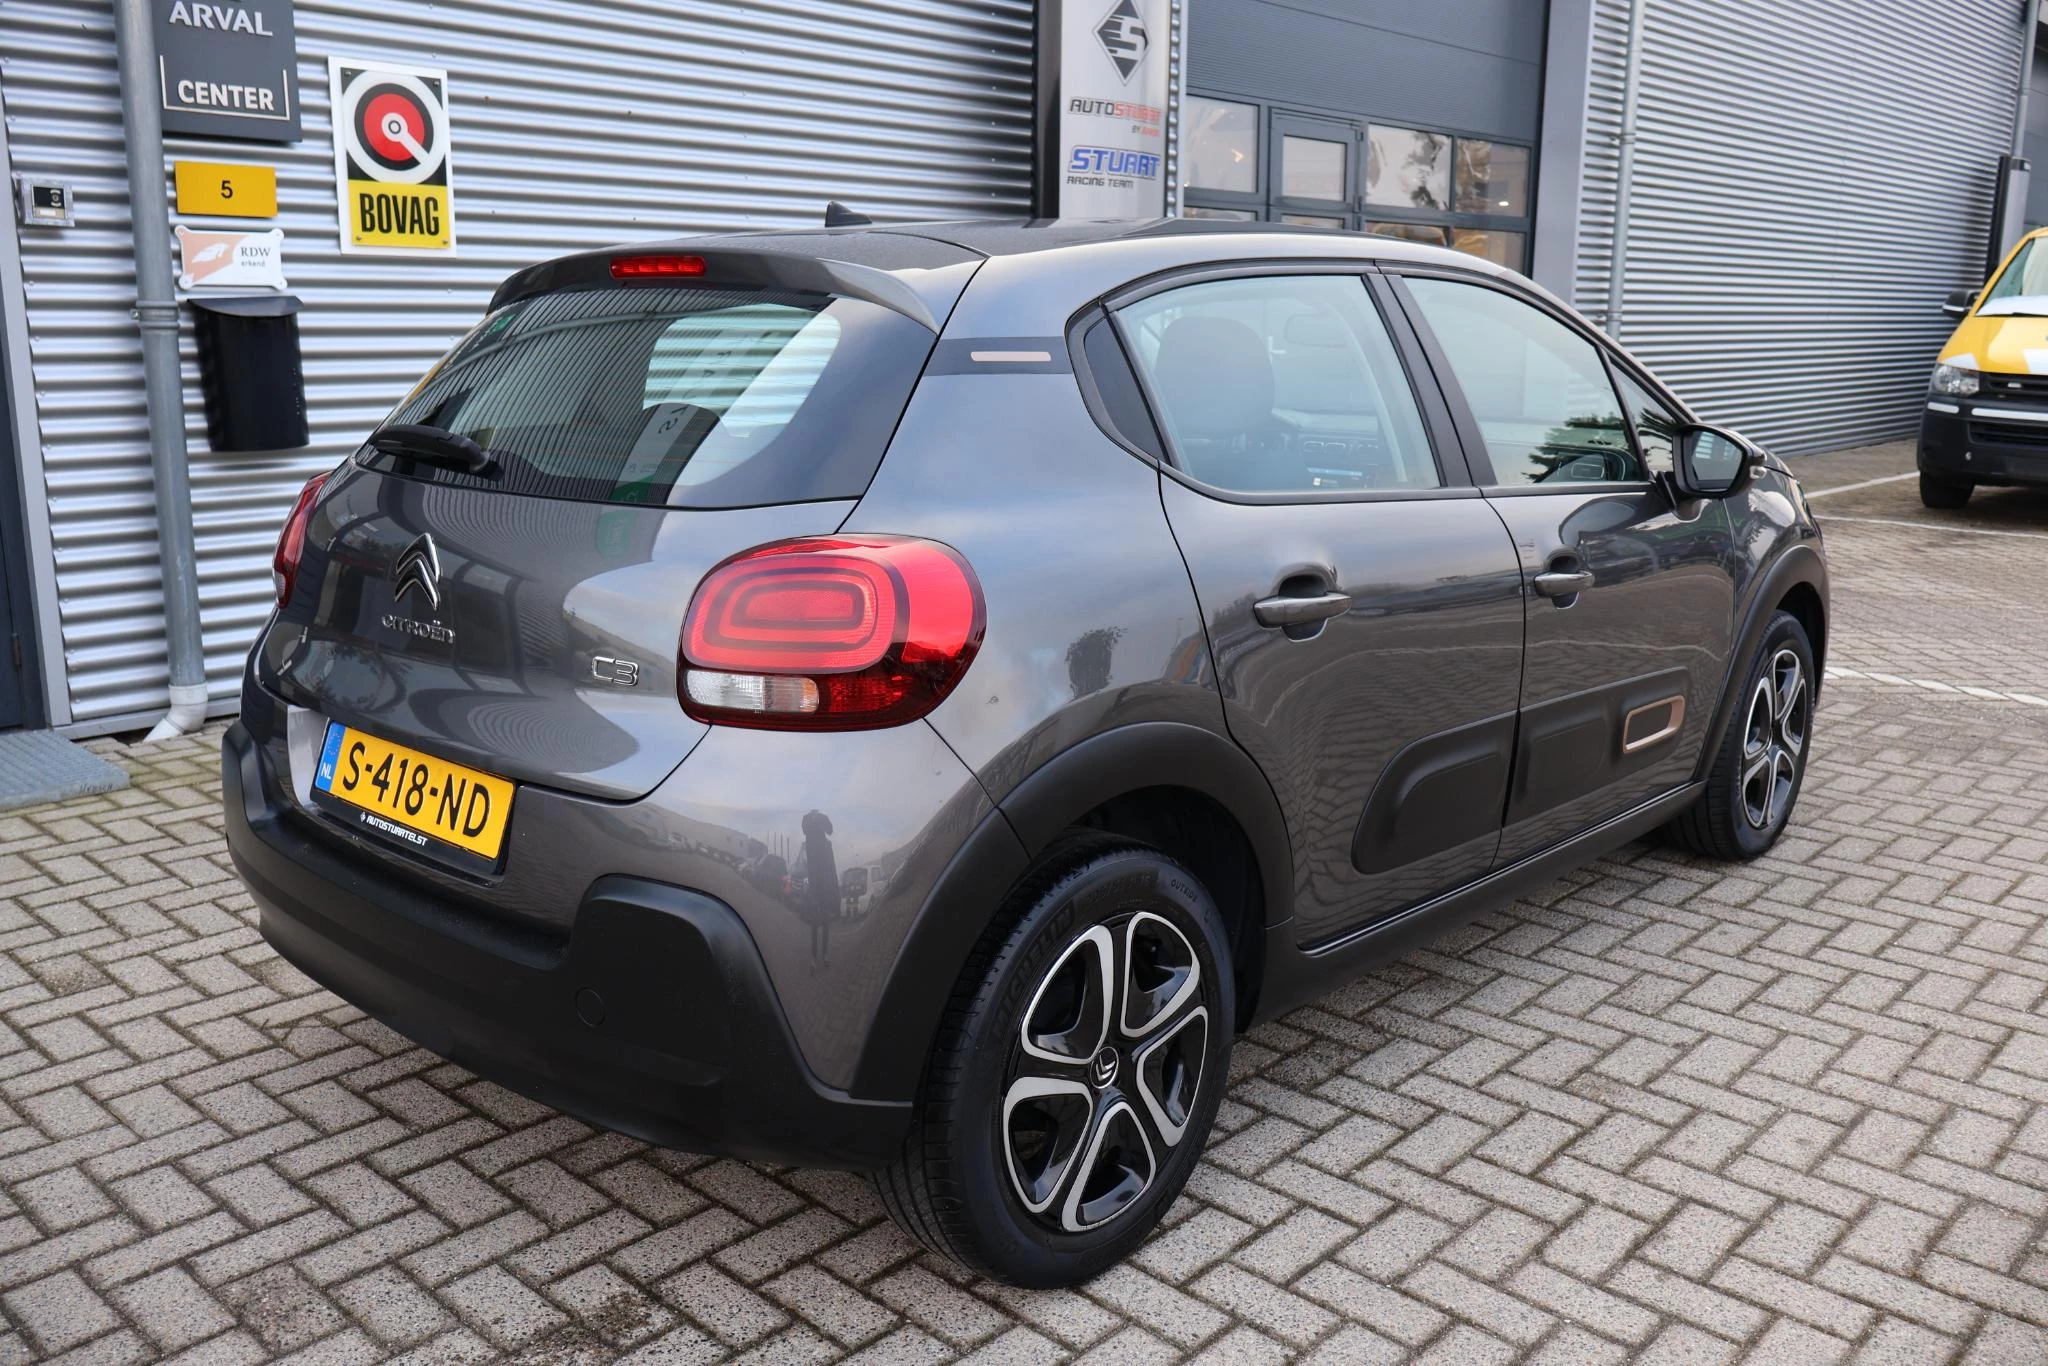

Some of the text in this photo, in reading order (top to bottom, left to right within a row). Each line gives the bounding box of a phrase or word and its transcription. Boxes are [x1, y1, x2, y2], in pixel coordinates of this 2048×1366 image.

[168, 0, 274, 36] ARVAL
[177, 79, 275, 111] CENTER
[1071, 148, 1161, 177] STUART
[220, 180, 234, 199] 5
[1066, 175, 1134, 188] RACING TEAM
[359, 192, 440, 236] BOVAG
[240, 246, 271, 257] RDW
[381, 613, 455, 644] CITROËN
[591, 655, 639, 686] C3
[320, 761, 333, 780] NL
[342, 741, 491, 838] S-418-ND
